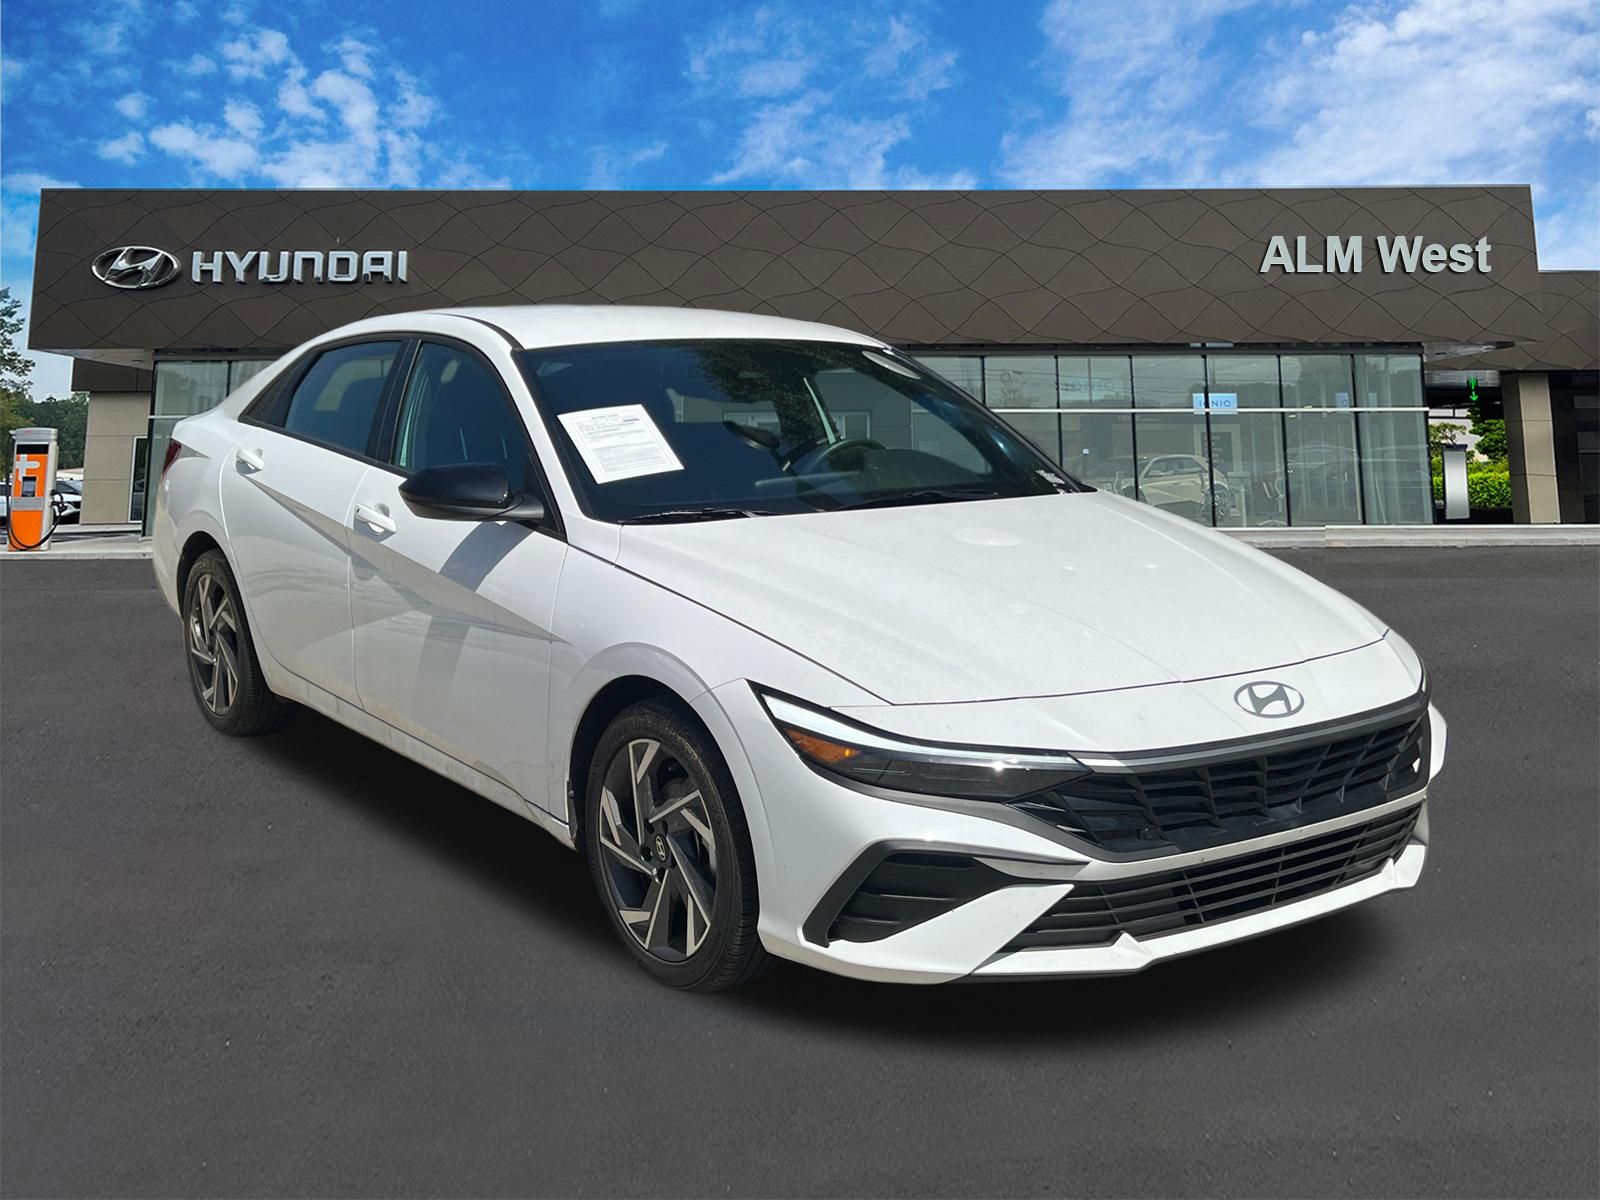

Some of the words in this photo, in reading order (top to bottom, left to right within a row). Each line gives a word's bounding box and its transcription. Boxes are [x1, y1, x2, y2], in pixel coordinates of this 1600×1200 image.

[192, 250, 408, 283] HYUNDAI
[1260, 235, 1363, 273] ALM
[1376, 235, 1493, 273] West
